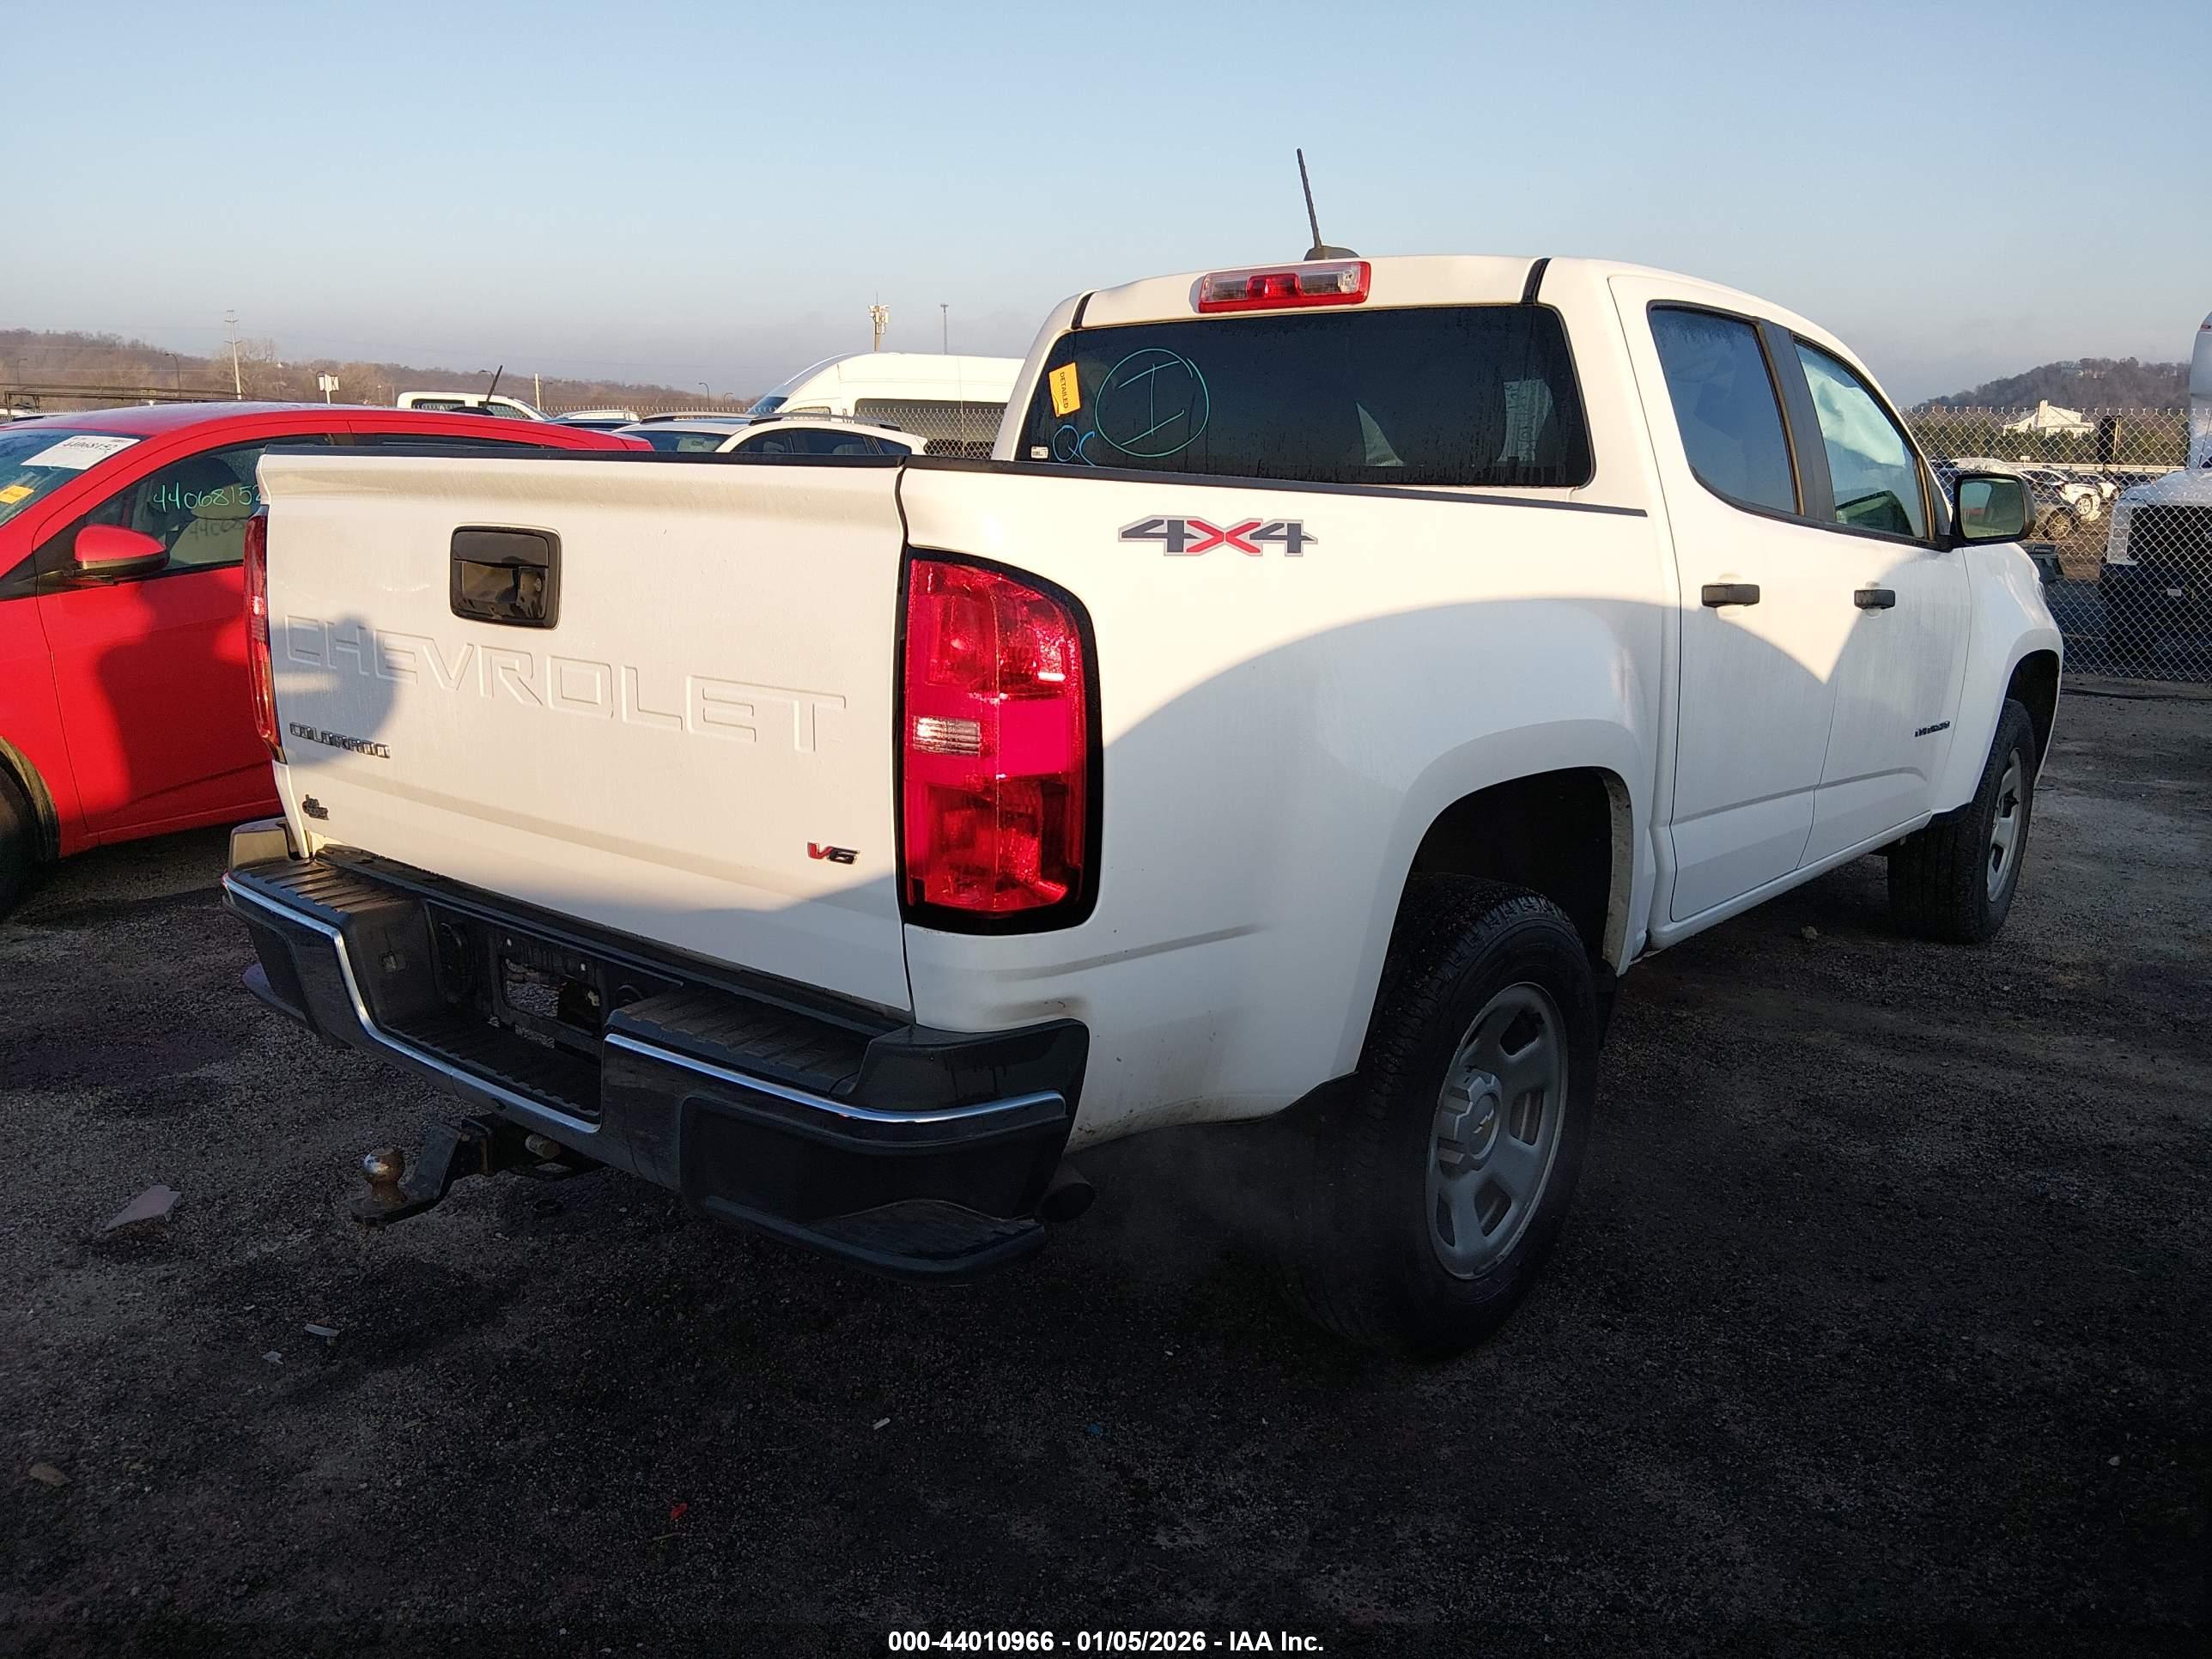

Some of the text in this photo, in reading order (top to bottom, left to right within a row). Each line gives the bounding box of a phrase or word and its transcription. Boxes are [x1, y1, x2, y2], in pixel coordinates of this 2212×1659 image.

[1059, 371, 1070, 410] DETAILED
[1052, 424, 1097, 467] QC
[285, 614, 847, 753] CHEVROLET
[289, 721, 391, 759] COLORADO
[807, 841, 860, 866] V6
